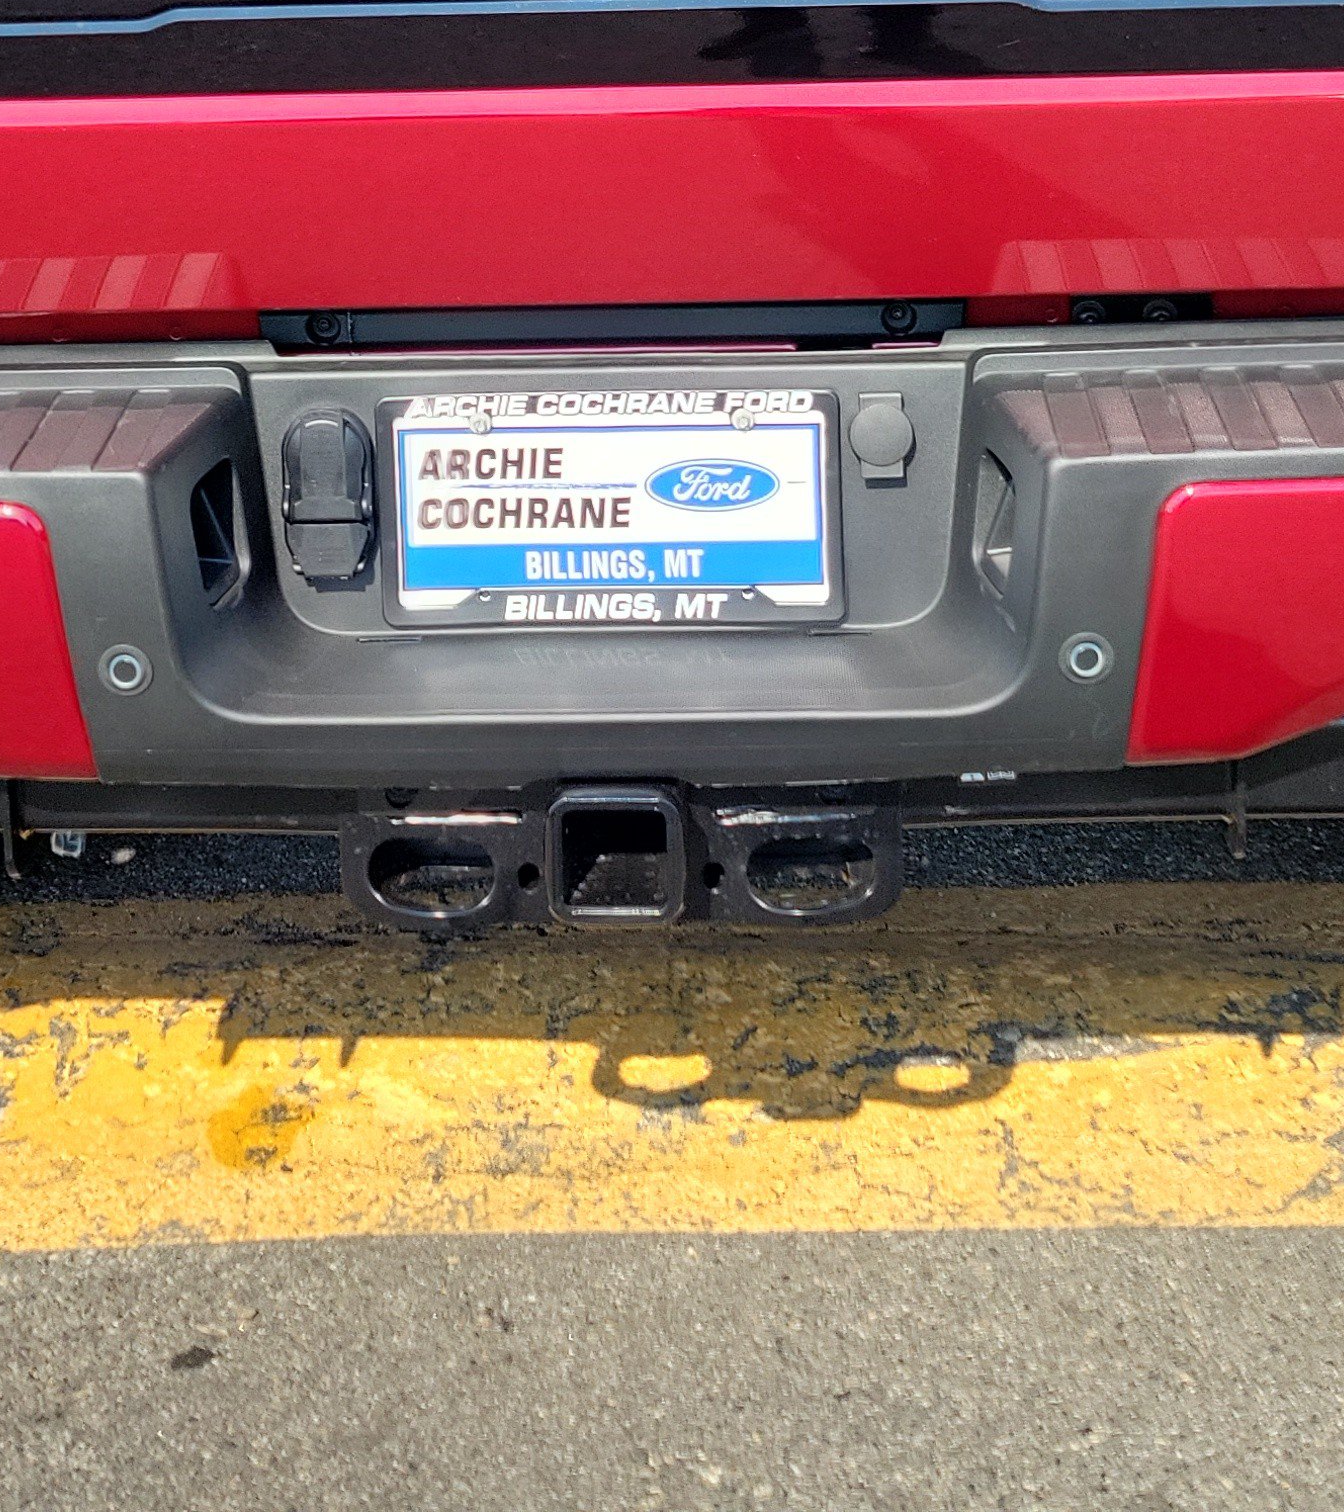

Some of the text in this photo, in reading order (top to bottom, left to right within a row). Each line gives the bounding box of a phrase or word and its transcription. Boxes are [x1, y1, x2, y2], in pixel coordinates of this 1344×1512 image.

[404, 390, 814, 419] ARCHIE COCHRANE FORD
[418, 447, 564, 481] ARCHIE
[672, 466, 752, 502] Ford
[417, 497, 632, 530] COCHRANE
[525, 549, 705, 583] BILLINGS, MT
[504, 593, 729, 622] BILLINGS, MT
